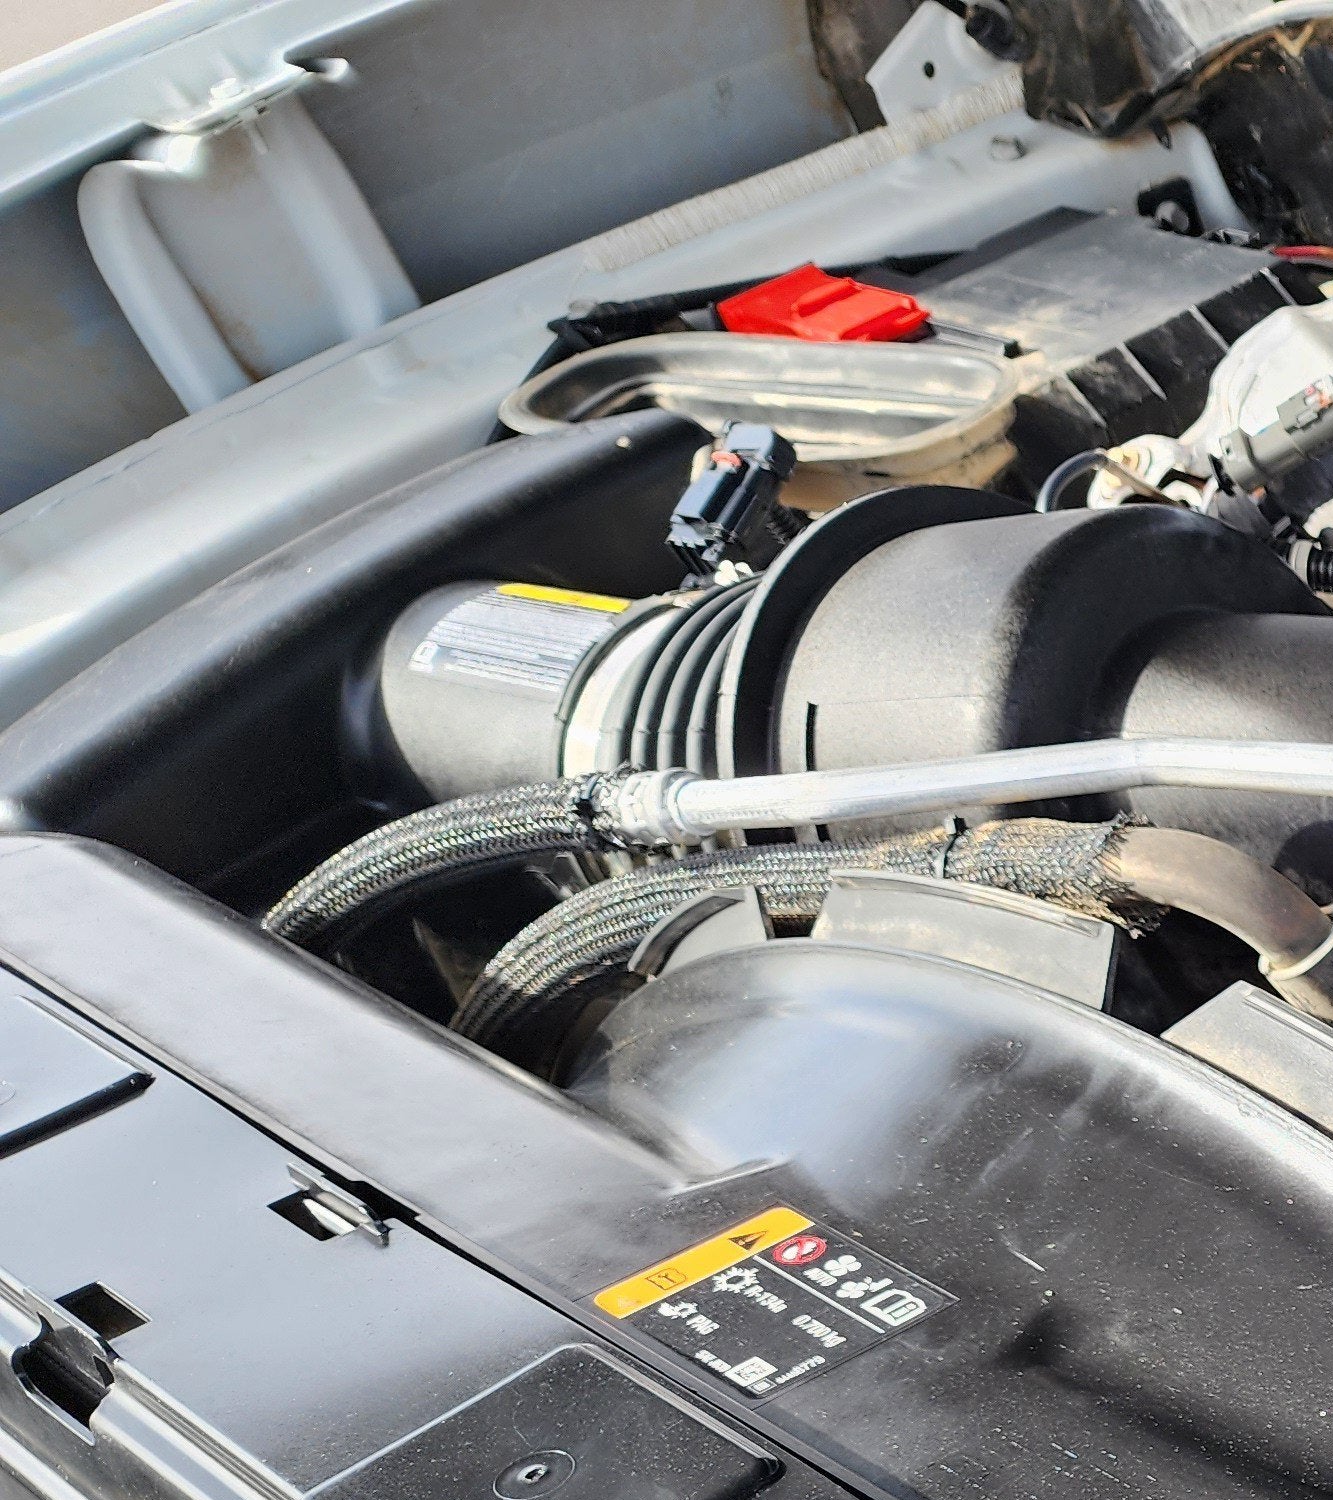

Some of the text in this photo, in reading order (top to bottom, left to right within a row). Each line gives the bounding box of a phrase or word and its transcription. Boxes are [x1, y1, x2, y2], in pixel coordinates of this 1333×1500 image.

[802, 1267, 837, 1287] AUTO
[743, 1284, 788, 1313] R-134a
[686, 1313, 720, 1335] PAG
